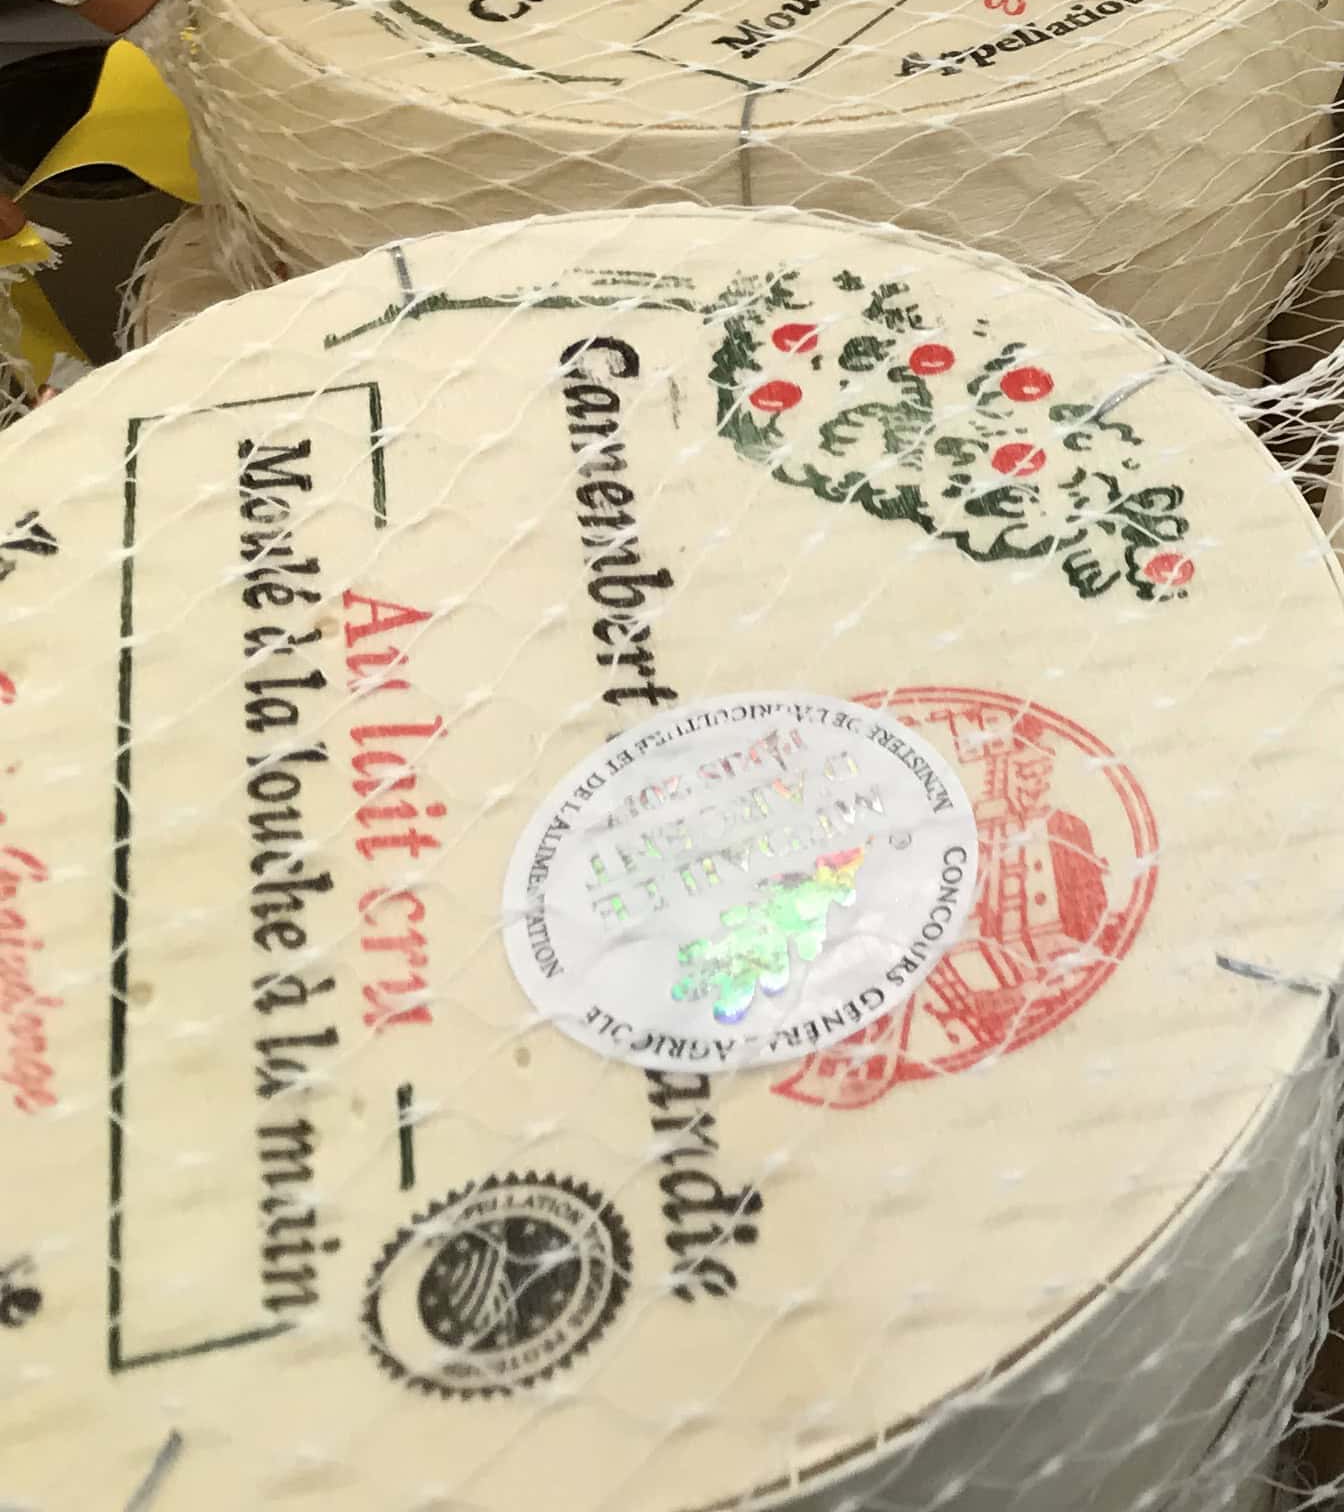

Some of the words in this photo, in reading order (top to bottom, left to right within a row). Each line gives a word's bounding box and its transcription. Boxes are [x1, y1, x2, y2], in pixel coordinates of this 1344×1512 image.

[237, 438, 323, 611] Moulé
[556, 333, 681, 710] Camembert
[244, 668, 328, 733] la
[342, 587, 434, 695] Au
[246, 741, 335, 952] louche
[348, 714, 450, 862] lait
[357, 886, 434, 1029] cru
